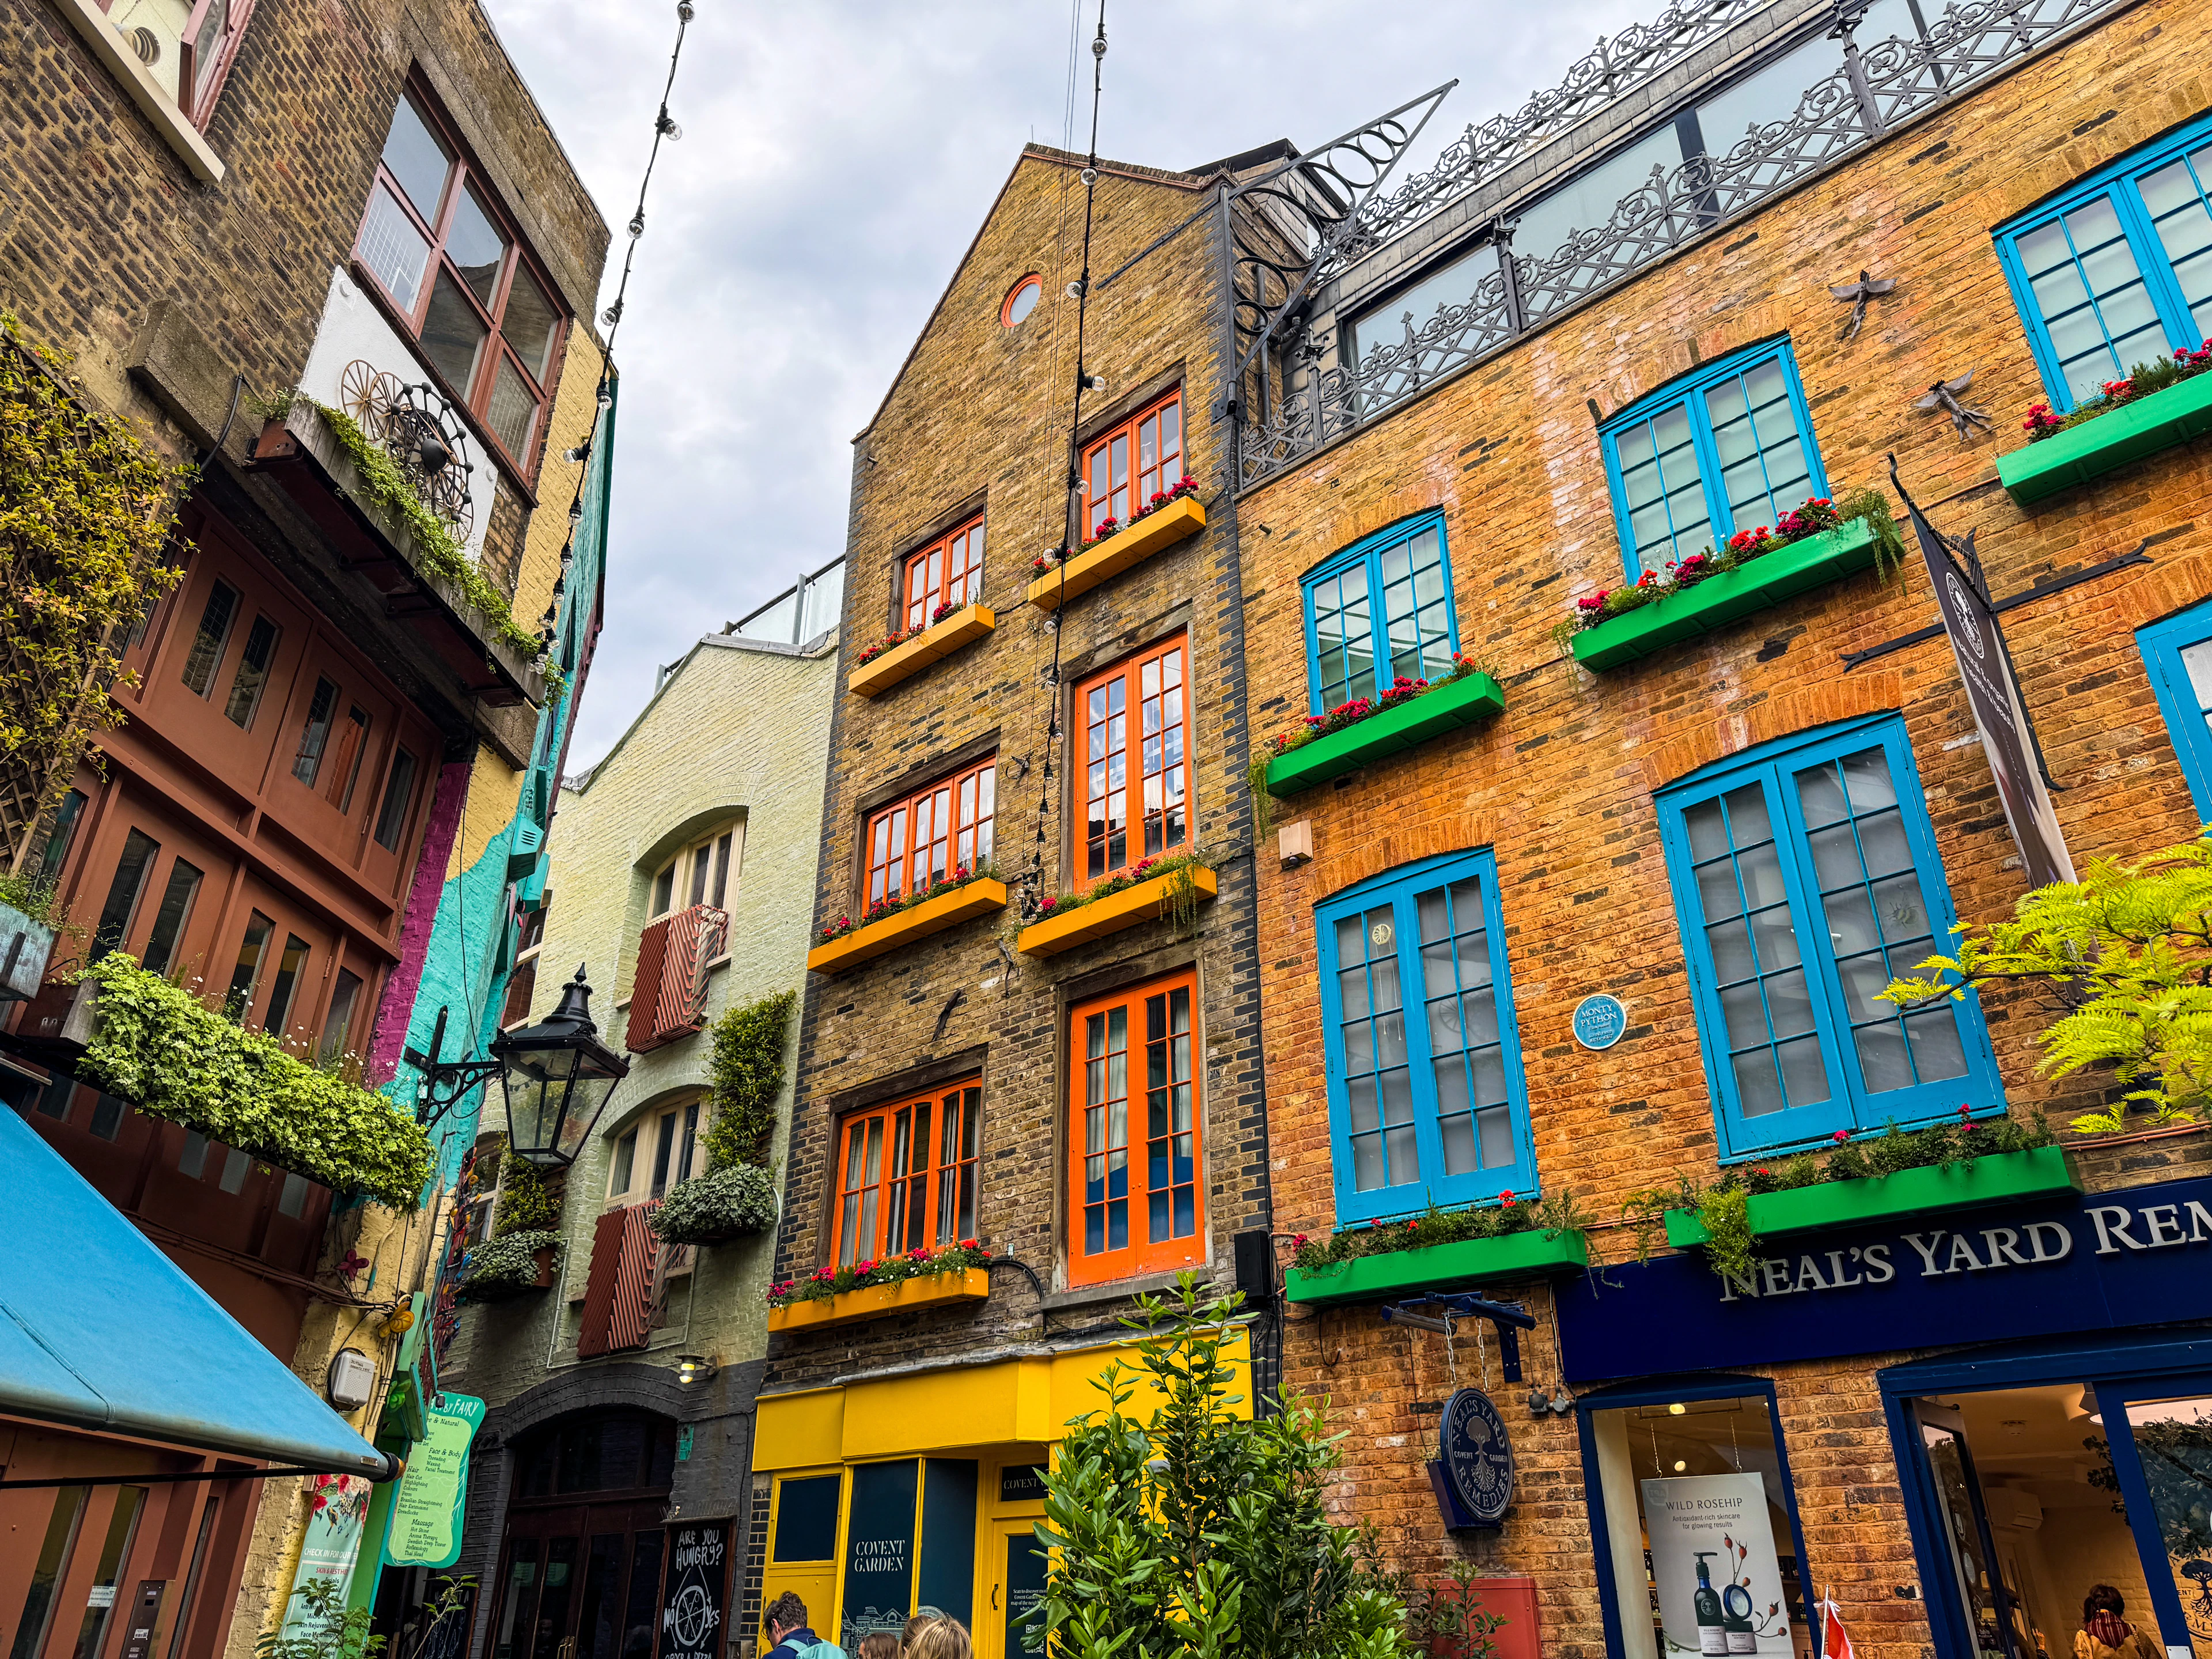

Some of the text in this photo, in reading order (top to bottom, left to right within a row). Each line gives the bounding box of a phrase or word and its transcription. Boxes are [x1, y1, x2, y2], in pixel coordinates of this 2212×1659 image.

[1953, 634, 1980, 675] Natural
[1980, 668, 1987, 683] &
[1987, 679, 2011, 713] organic
[1964, 660, 1987, 696] health
[1987, 689, 1994, 704] &
[1991, 695, 2015, 734] beauty
[1581, 1003, 1612, 1018] MONTY
[1581, 1012, 1618, 1027] PYTHON
[1719, 1244, 1895, 1302] NEAL'S
[1900, 1221, 2073, 1277] YARD
[452, 1399, 479, 1417] FAIRY
[440, 1418, 460, 1426] Natural
[1453, 1400, 1505, 1449] NEAL'S YARD
[448, 1450, 461, 1459] Body
[1454, 1450, 1508, 1463] COVENT GARDEN
[404, 1479, 428, 1487] Highlighting
[1003, 1478, 1038, 1490] COVENT
[1457, 1465, 1508, 1507] REMEDIES
[418, 1499, 442, 1508] Straightening
[1666, 1498, 1743, 1510] WILD ROSEHIP
[411, 1518, 434, 1528] Massage
[1672, 1514, 1715, 1522] Antioxidant-rich
[1691, 1522, 1713, 1530] glowing
[678, 1528, 719, 1547] ARE YOU
[304, 1548, 323, 1556] CHECK
[329, 1550, 339, 1558] FOR
[339, 1551, 351, 1559] OUR
[406, 1544, 428, 1552] Reflexology
[856, 1540, 905, 1555] COVENT
[676, 1543, 723, 1571] HUNGRY?
[854, 1556, 904, 1572] GARDEN
[664, 1608, 675, 1633] NO
[704, 1605, 719, 1628] YES
